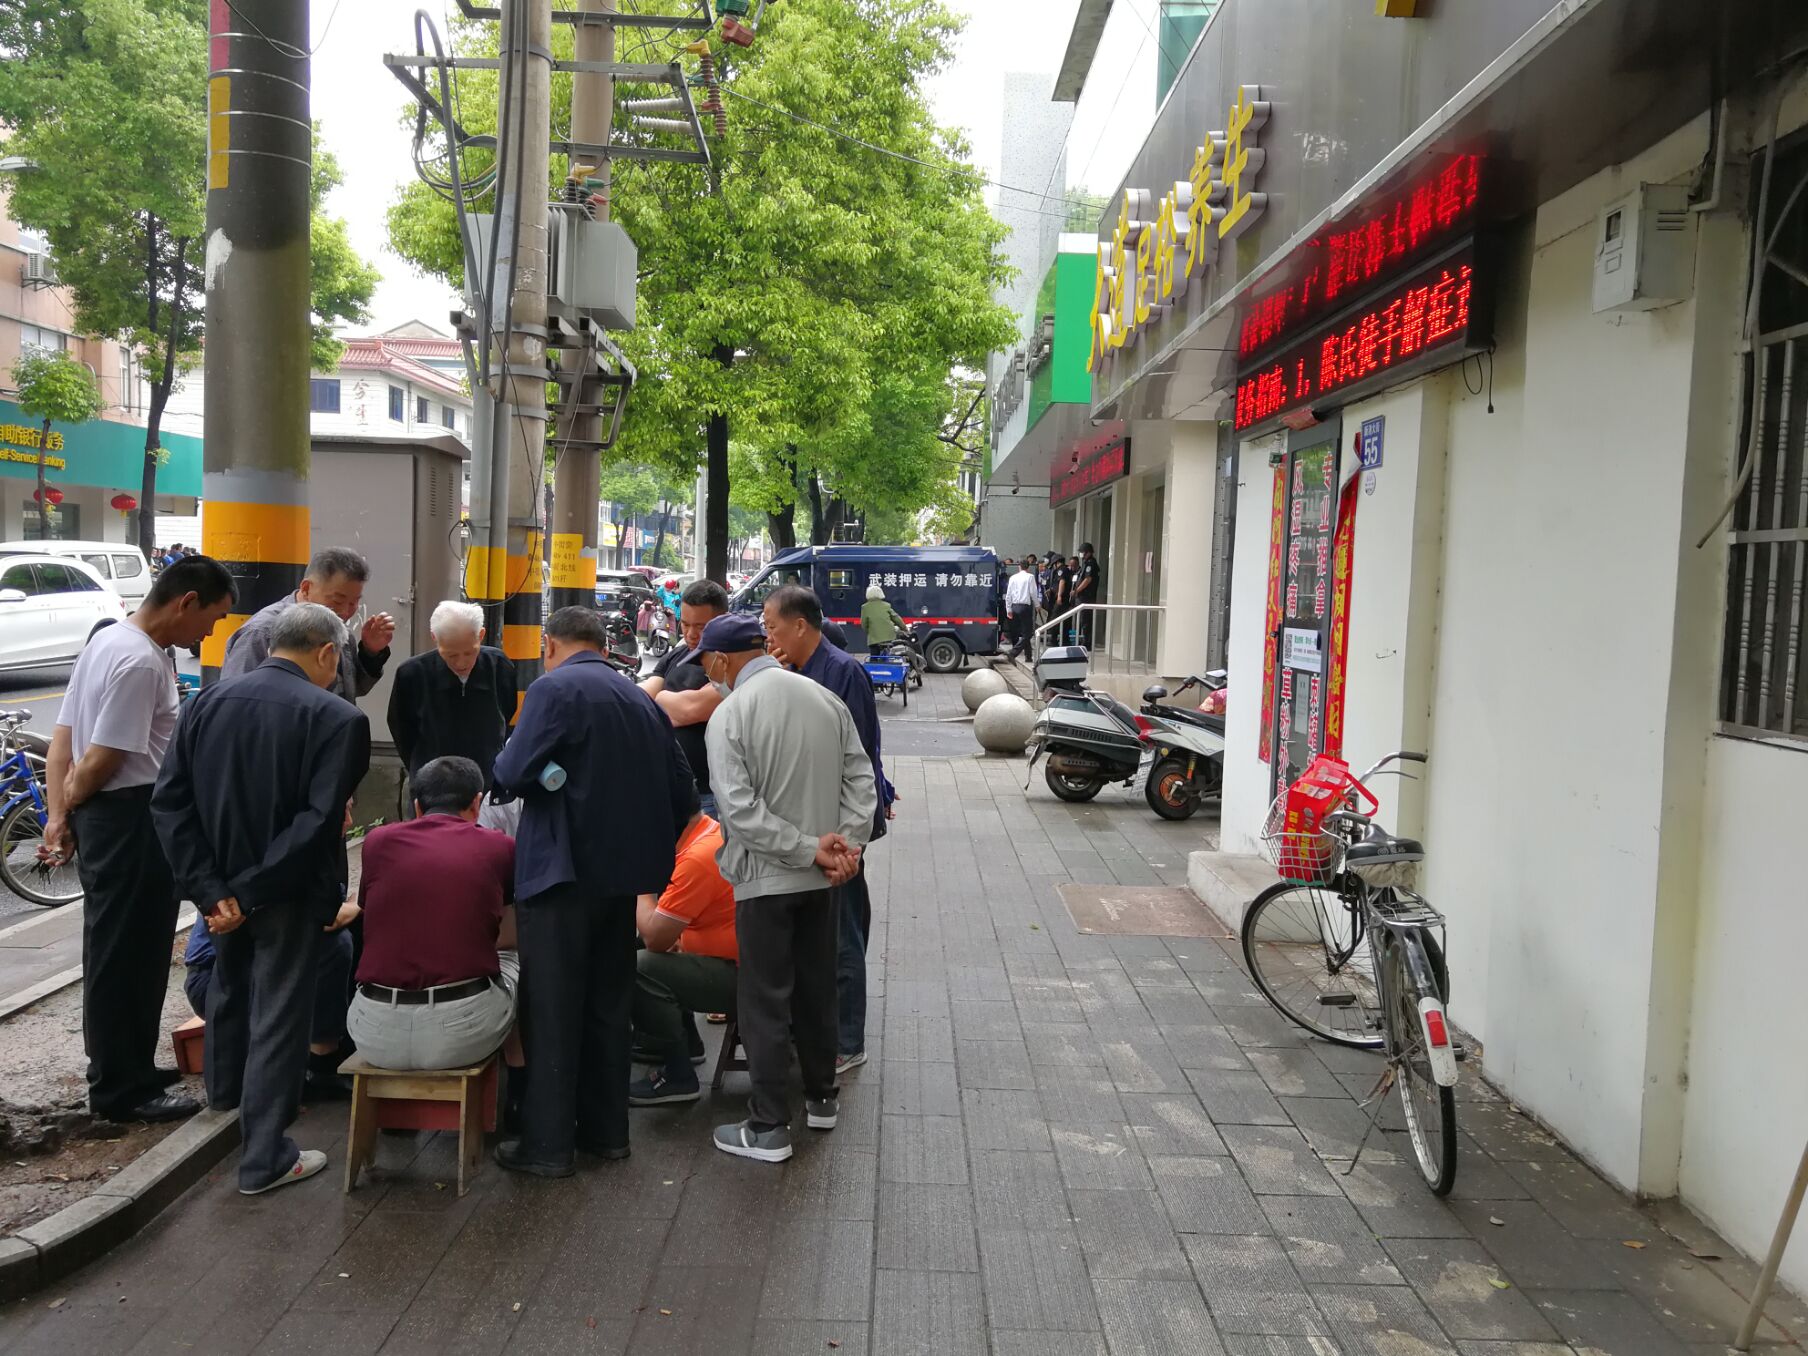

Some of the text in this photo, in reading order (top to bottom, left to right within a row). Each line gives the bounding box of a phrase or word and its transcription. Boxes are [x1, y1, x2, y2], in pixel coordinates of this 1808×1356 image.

[1364, 436, 1378, 466] 55
[38, 453, 65, 470] anking
[868, 572, 993, 588] 武装押运 请勿靠近
